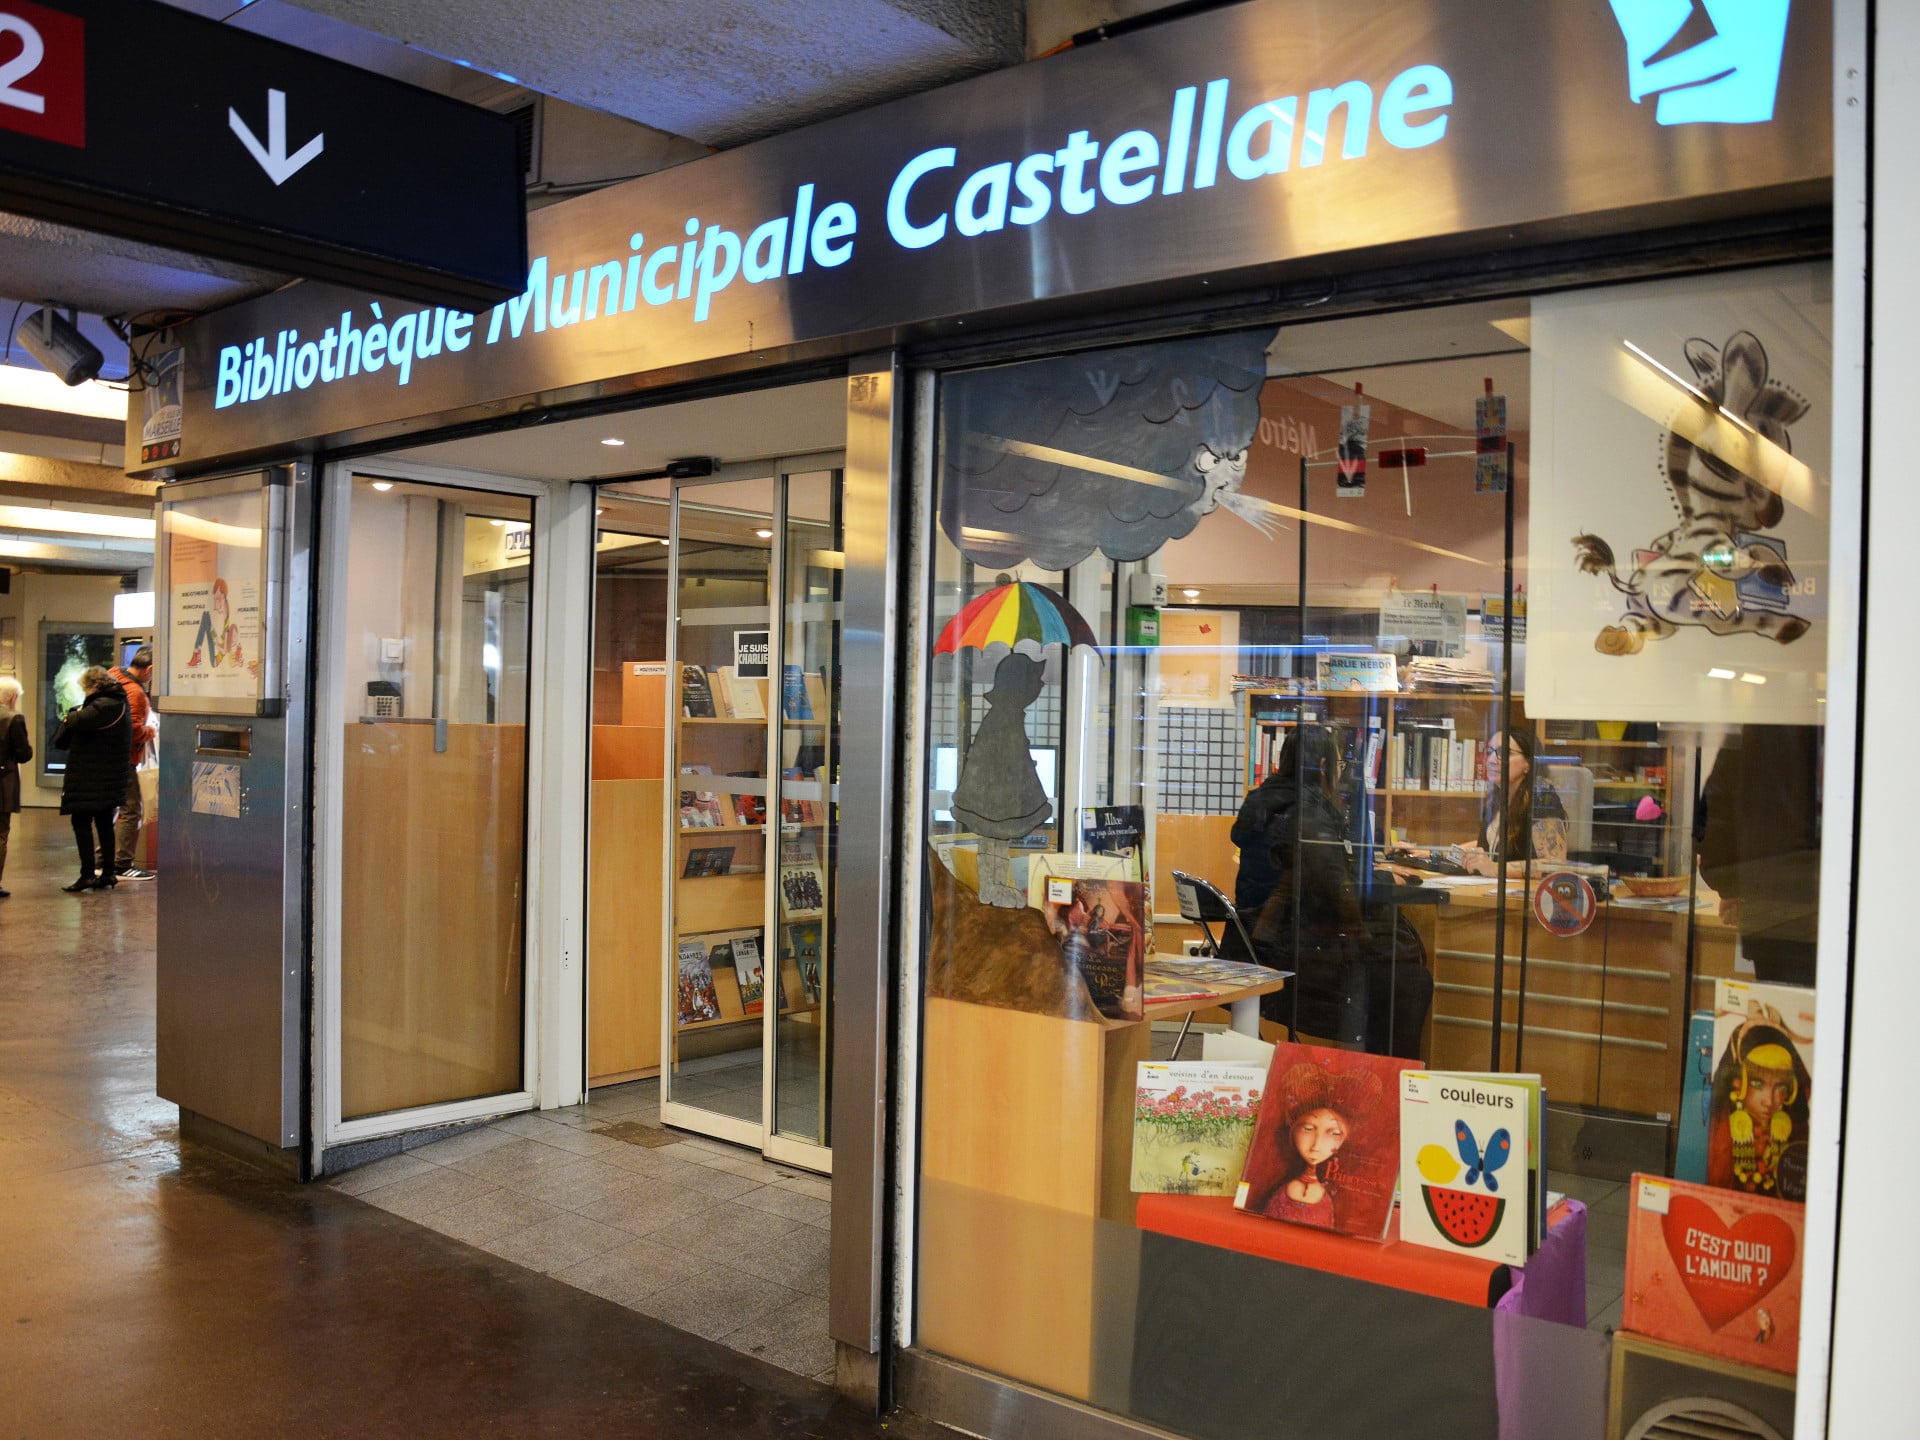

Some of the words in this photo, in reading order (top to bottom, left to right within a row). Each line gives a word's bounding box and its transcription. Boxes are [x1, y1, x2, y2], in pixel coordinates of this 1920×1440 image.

[0, 12, 45, 114] 2
[216, 302, 474, 409] Bibliothèque
[486, 183, 858, 345] Municipale
[886, 64, 1454, 249] Castellane
[738, 644, 749, 652] JE
[750, 644, 768, 652] SUIS
[738, 653, 768, 664] CHARLIE
[1360, 660, 1392, 669] HEBDO
[1440, 1088, 1514, 1109] couleurs
[1685, 1227, 1732, 1259] C'EST
[1734, 1240, 1772, 1265] QUOI
[1686, 1254, 1752, 1285] L'AMOUR
[1757, 1268, 1768, 1287] ?
